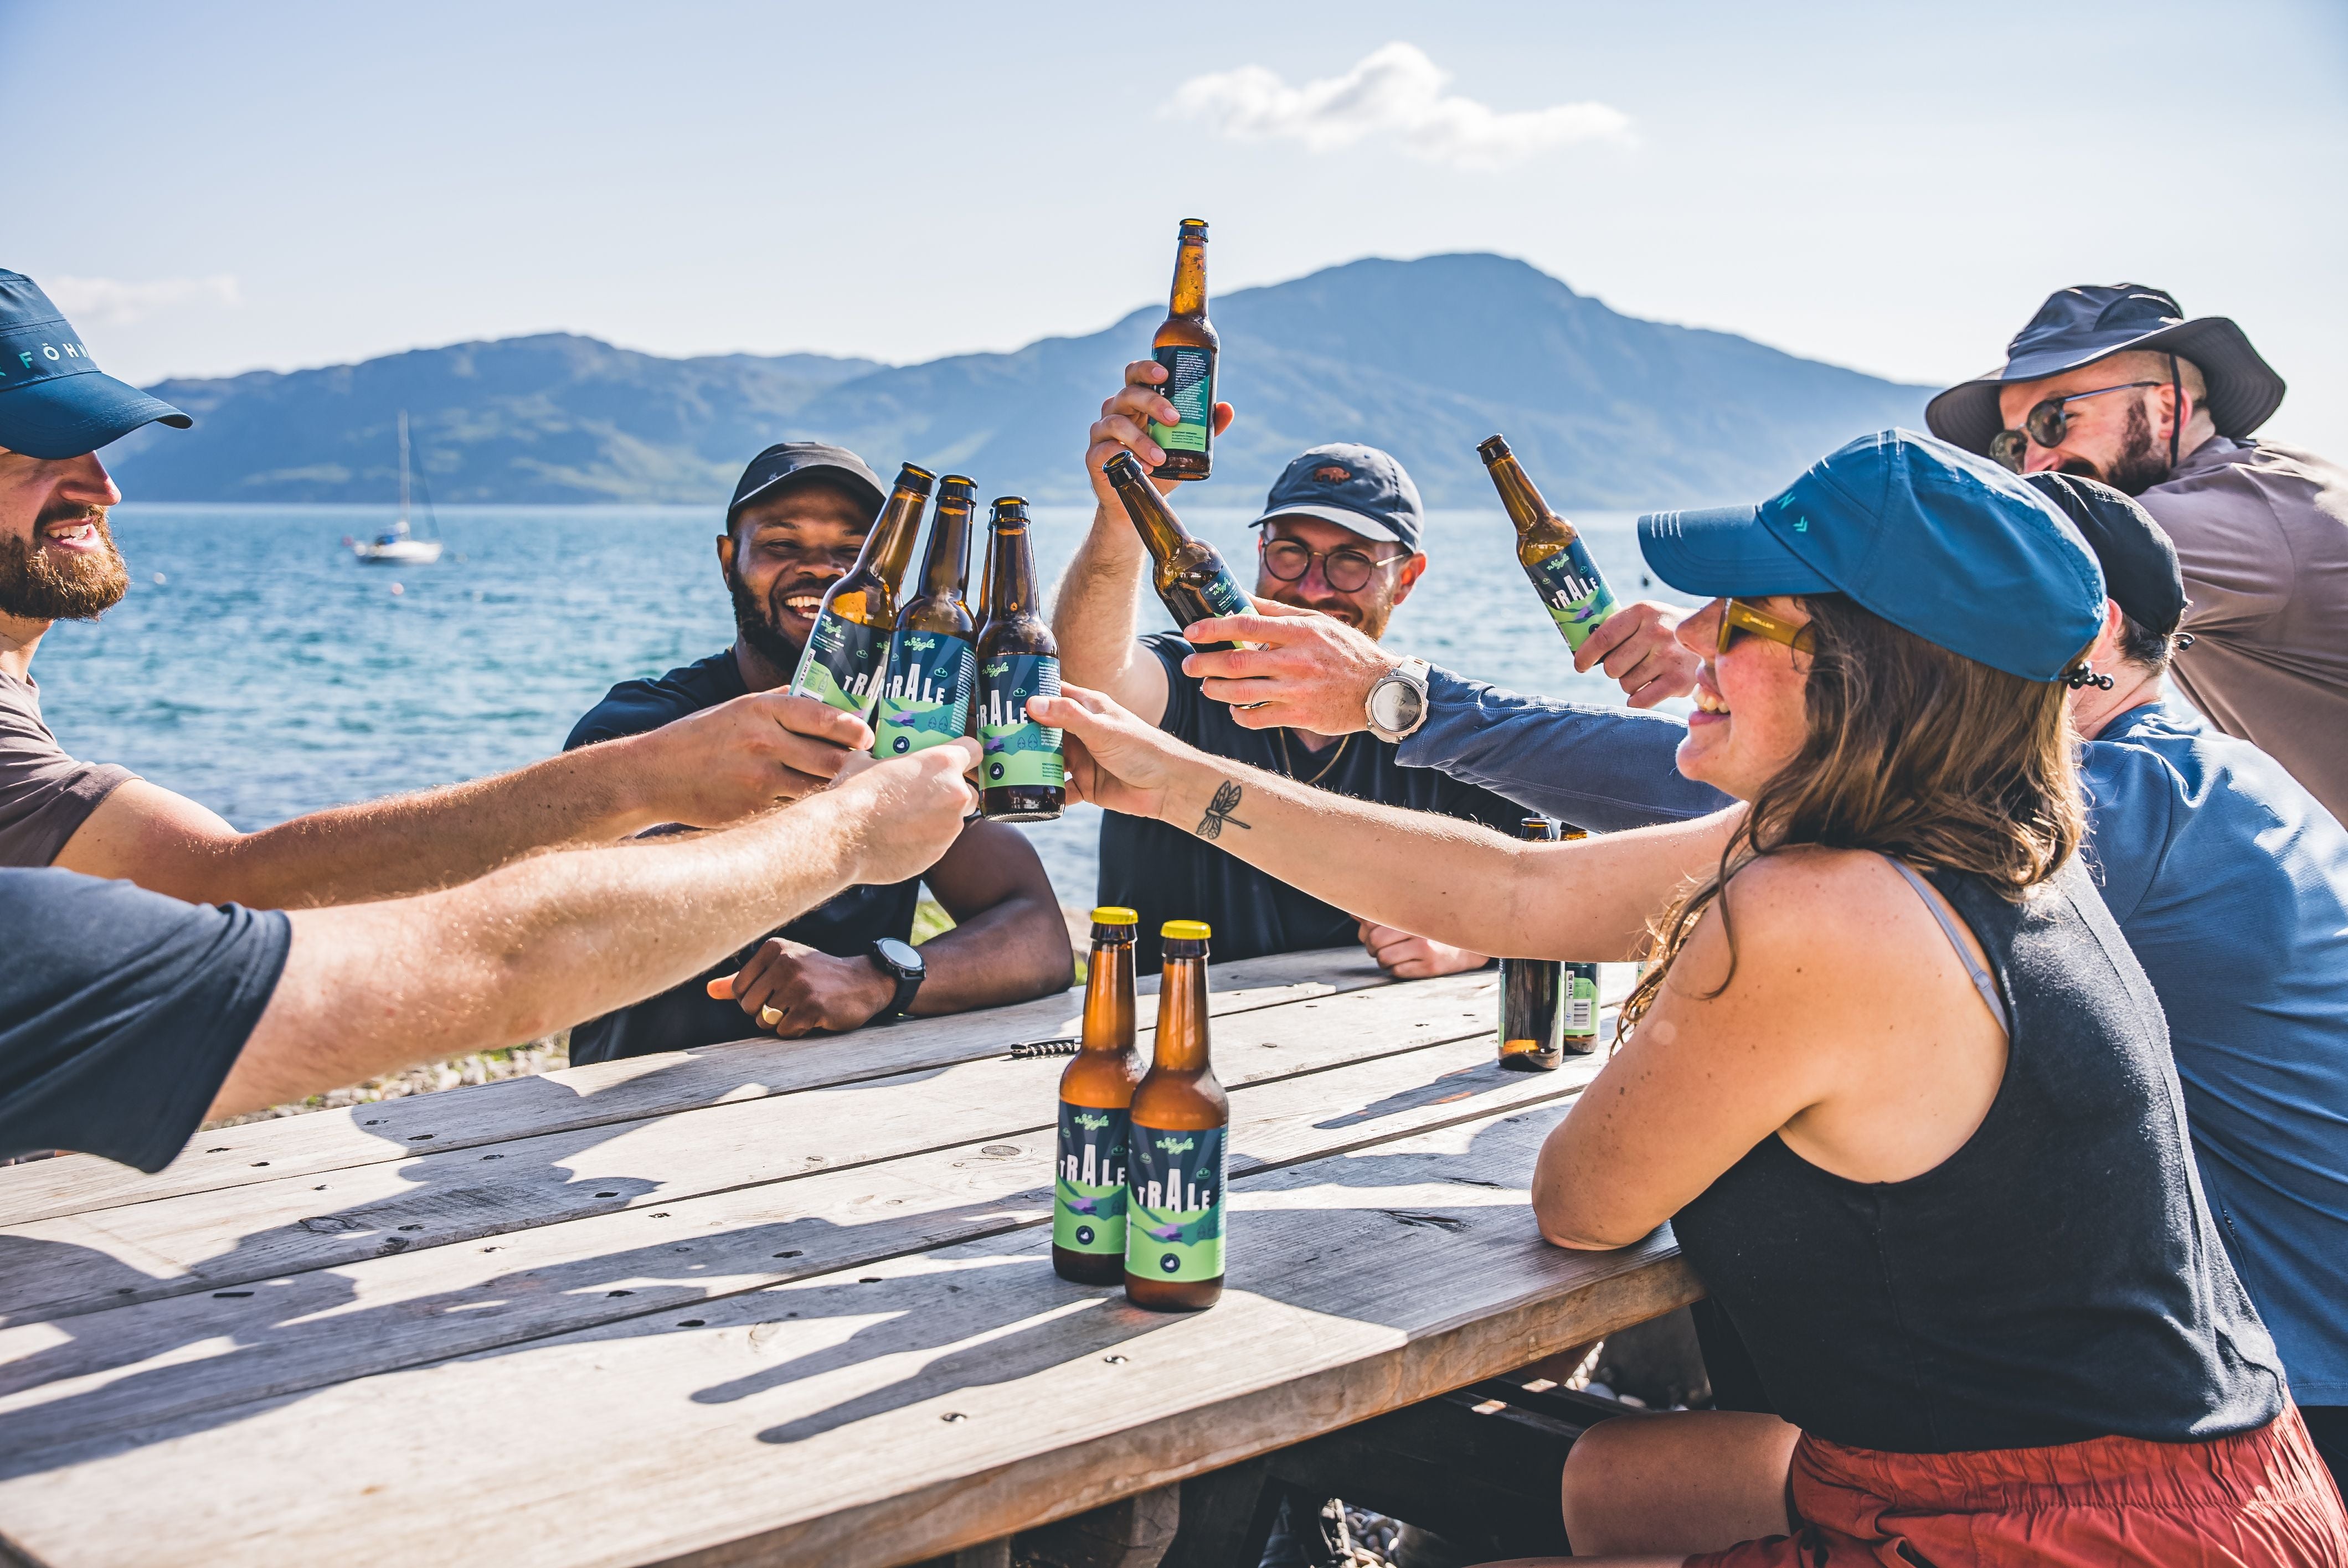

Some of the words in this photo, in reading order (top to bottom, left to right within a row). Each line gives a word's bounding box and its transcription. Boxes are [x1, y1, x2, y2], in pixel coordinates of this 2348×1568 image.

[18, 342, 90, 369] FÖHN
[1551, 575, 1599, 609] TRALE
[885, 663, 946, 705] TRALE
[1059, 1143, 1126, 1189] TRALE
[1137, 1168, 1211, 1214] TRALE
